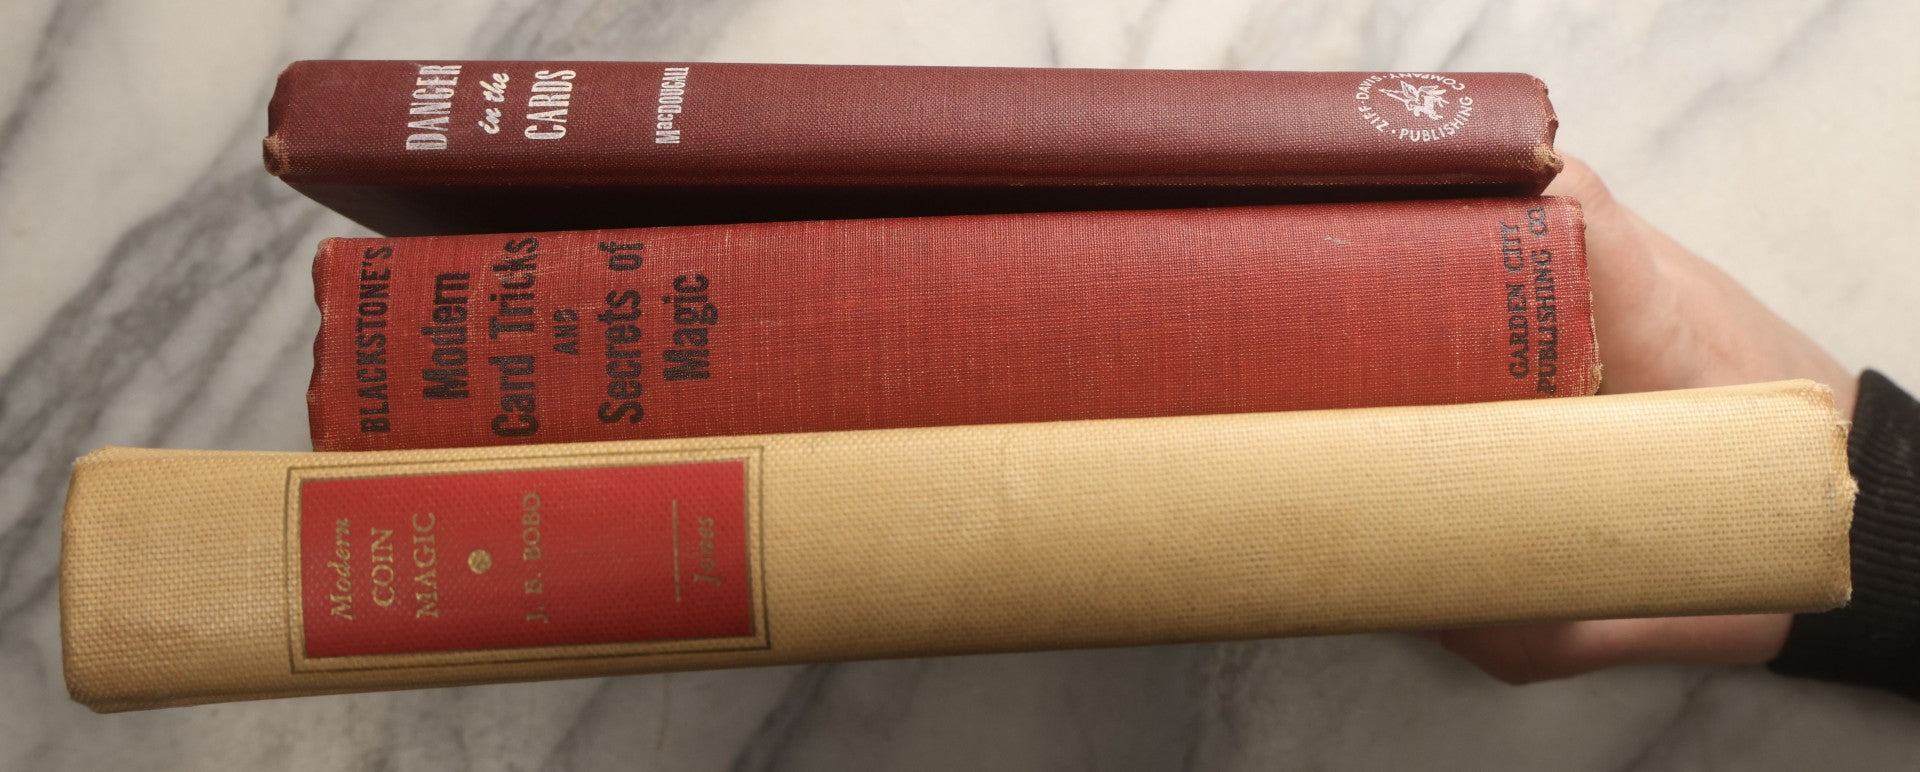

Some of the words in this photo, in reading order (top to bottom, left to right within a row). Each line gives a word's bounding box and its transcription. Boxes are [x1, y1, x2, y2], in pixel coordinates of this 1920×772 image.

[405, 64, 462, 150] DANGER
[479, 72, 510, 103] the
[524, 69, 577, 140] CARDS
[655, 67, 690, 144] MacDOUGALL
[1389, 73, 1466, 91] COMPANY
[1398, 96, 1474, 142] PUBLISHING
[478, 107, 502, 135] in
[597, 240, 644, 272] of
[1500, 221, 1525, 272] CITY
[489, 237, 539, 340] Tricks
[1531, 249, 1559, 394] PUBLISHING
[355, 246, 393, 433] BLACKSTONE'S
[420, 271, 470, 400] Modern
[553, 308, 579, 355] AND
[597, 289, 644, 424] Secrets
[661, 273, 718, 382] Magic
[1506, 282, 1530, 380] GARDEN
[490, 354, 539, 437] Card
[521, 491, 542, 562] BOBO
[693, 516, 722, 588] Jones
[328, 517, 353, 621] Modern
[371, 527, 395, 608] COIN
[411, 512, 441, 619] MAGIC
[524, 572, 544, 595] B.
[526, 601, 550, 624] J.
